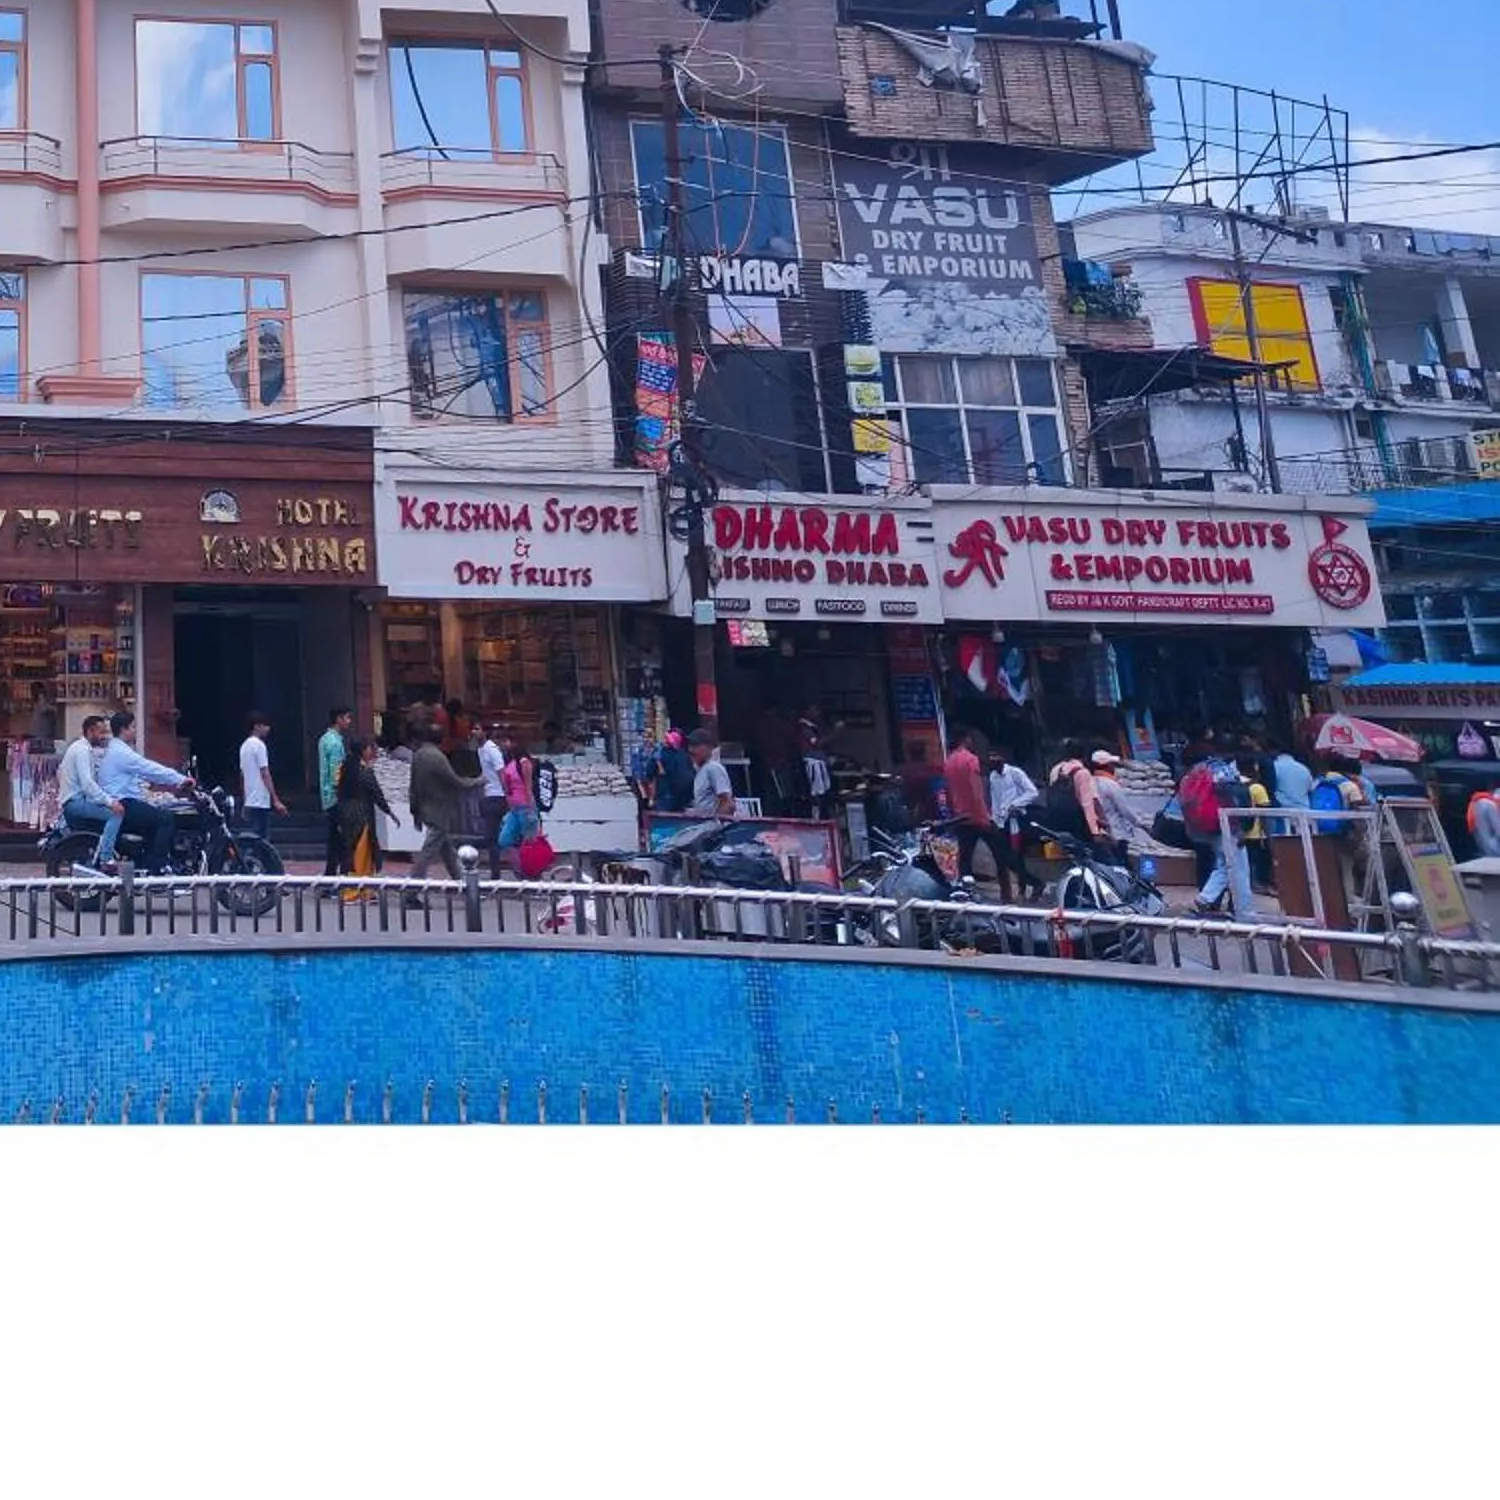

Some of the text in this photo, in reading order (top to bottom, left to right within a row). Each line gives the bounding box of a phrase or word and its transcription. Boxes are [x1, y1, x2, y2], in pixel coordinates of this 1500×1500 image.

[843, 182, 1021, 229] VASU
[871, 230, 1008, 255] DRY FRUIT
[699, 255, 799, 297] DHABA
[881, 255, 1034, 281] EMPORIUM
[14, 508, 144, 550] FRUITS
[397, 496, 640, 536] KRISHNA STORE
[712, 506, 900, 555] DHARMA
[513, 536, 532, 559] &
[1003, 515, 1292, 551] VASU DRY FRUITS
[201, 535, 368, 577] KRISHNA
[717, 556, 930, 587] ISHNO DHABA
[455, 561, 593, 588] DRY FRUITS
[817, 600, 865, 612] FASTFOOD
[1341, 687, 1421, 708] KASHMIR
[1426, 688, 1471, 708] ARTS
